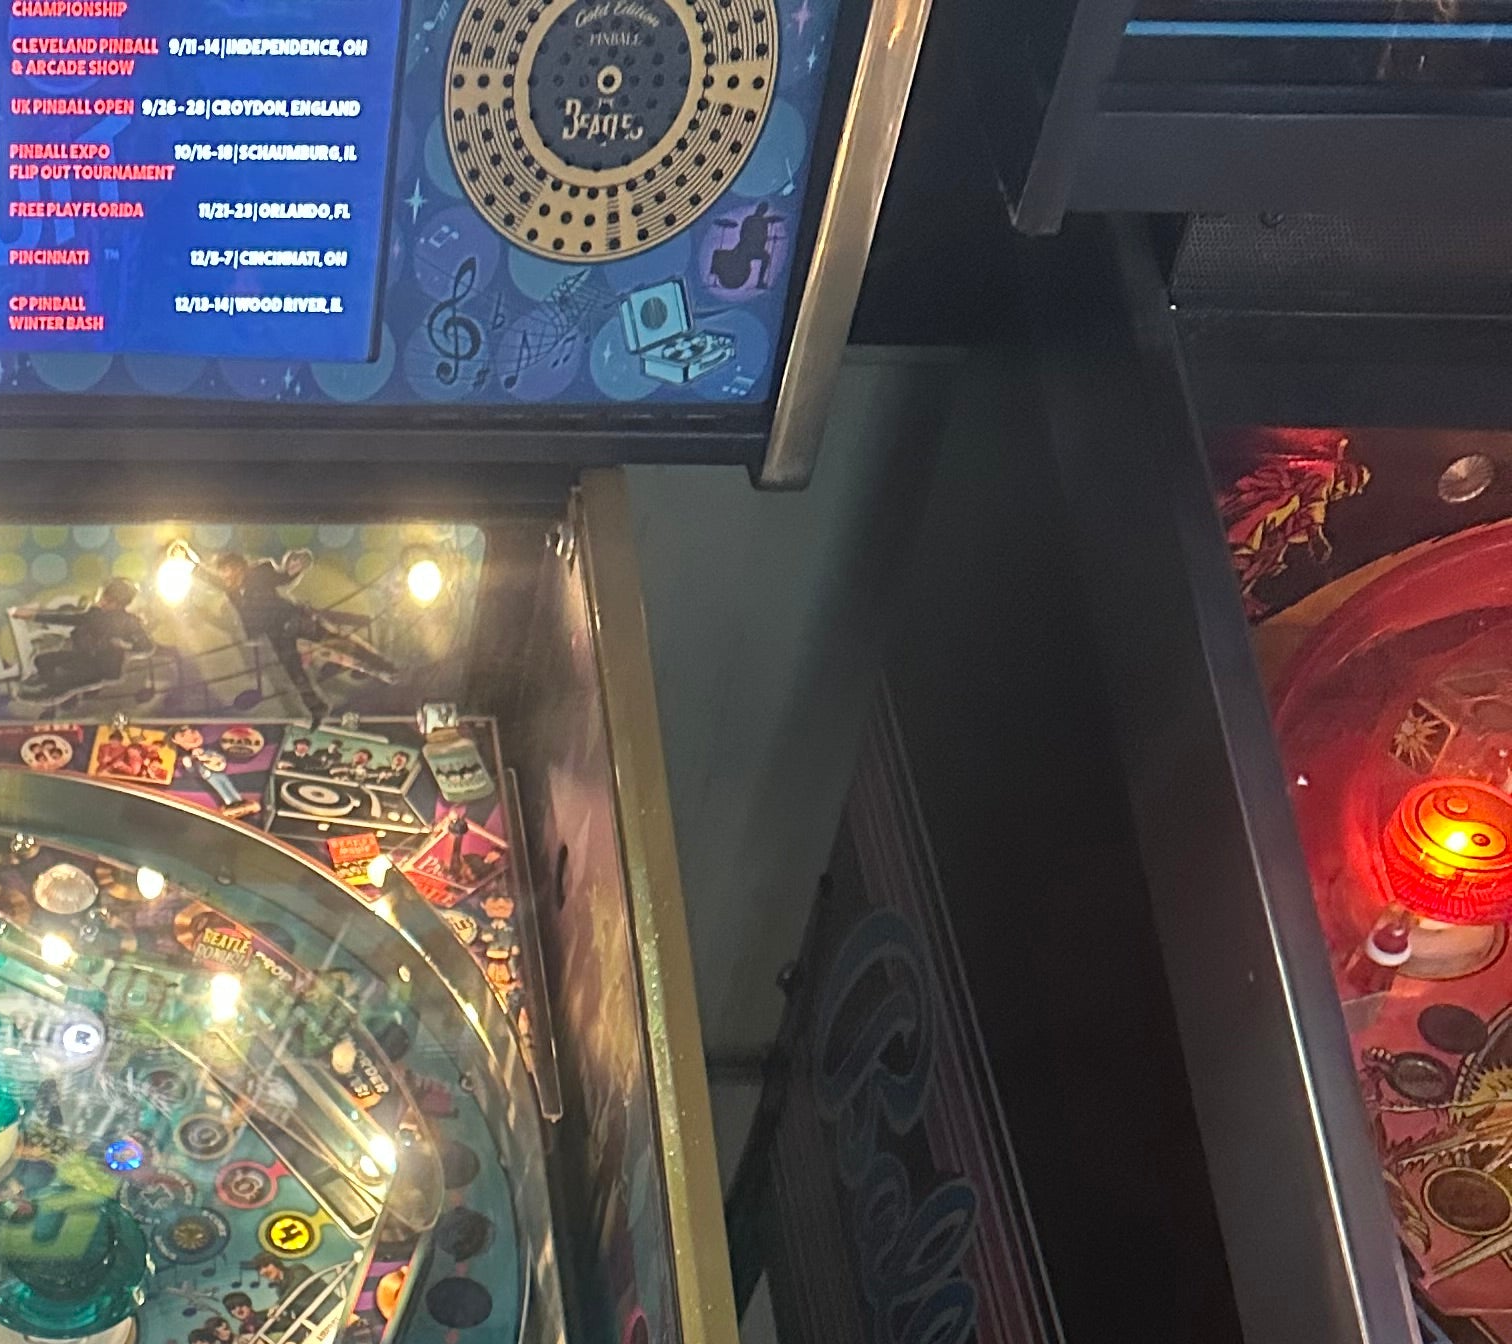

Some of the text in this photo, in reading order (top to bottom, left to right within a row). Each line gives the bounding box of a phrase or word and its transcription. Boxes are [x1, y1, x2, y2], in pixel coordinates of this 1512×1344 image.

[12, 1, 128, 17] CHAMPIONSHIP
[12, 38, 159, 54] CLEVELAND PINBALL
[26, 60, 135, 75] ARCADE SHOW
[11, 98, 134, 115] UK PINBALL OPEN
[9, 144, 110, 159] PINBALL EXPO
[9, 165, 175, 180] FLIP OUT TOURNAMENT
[9, 203, 144, 218] FREE PLAY FLORIDA
[9, 250, 89, 265] PINCINNATI
[29, 297, 86, 311] PINBALL
[9, 316, 104, 331] WINTER BASH
